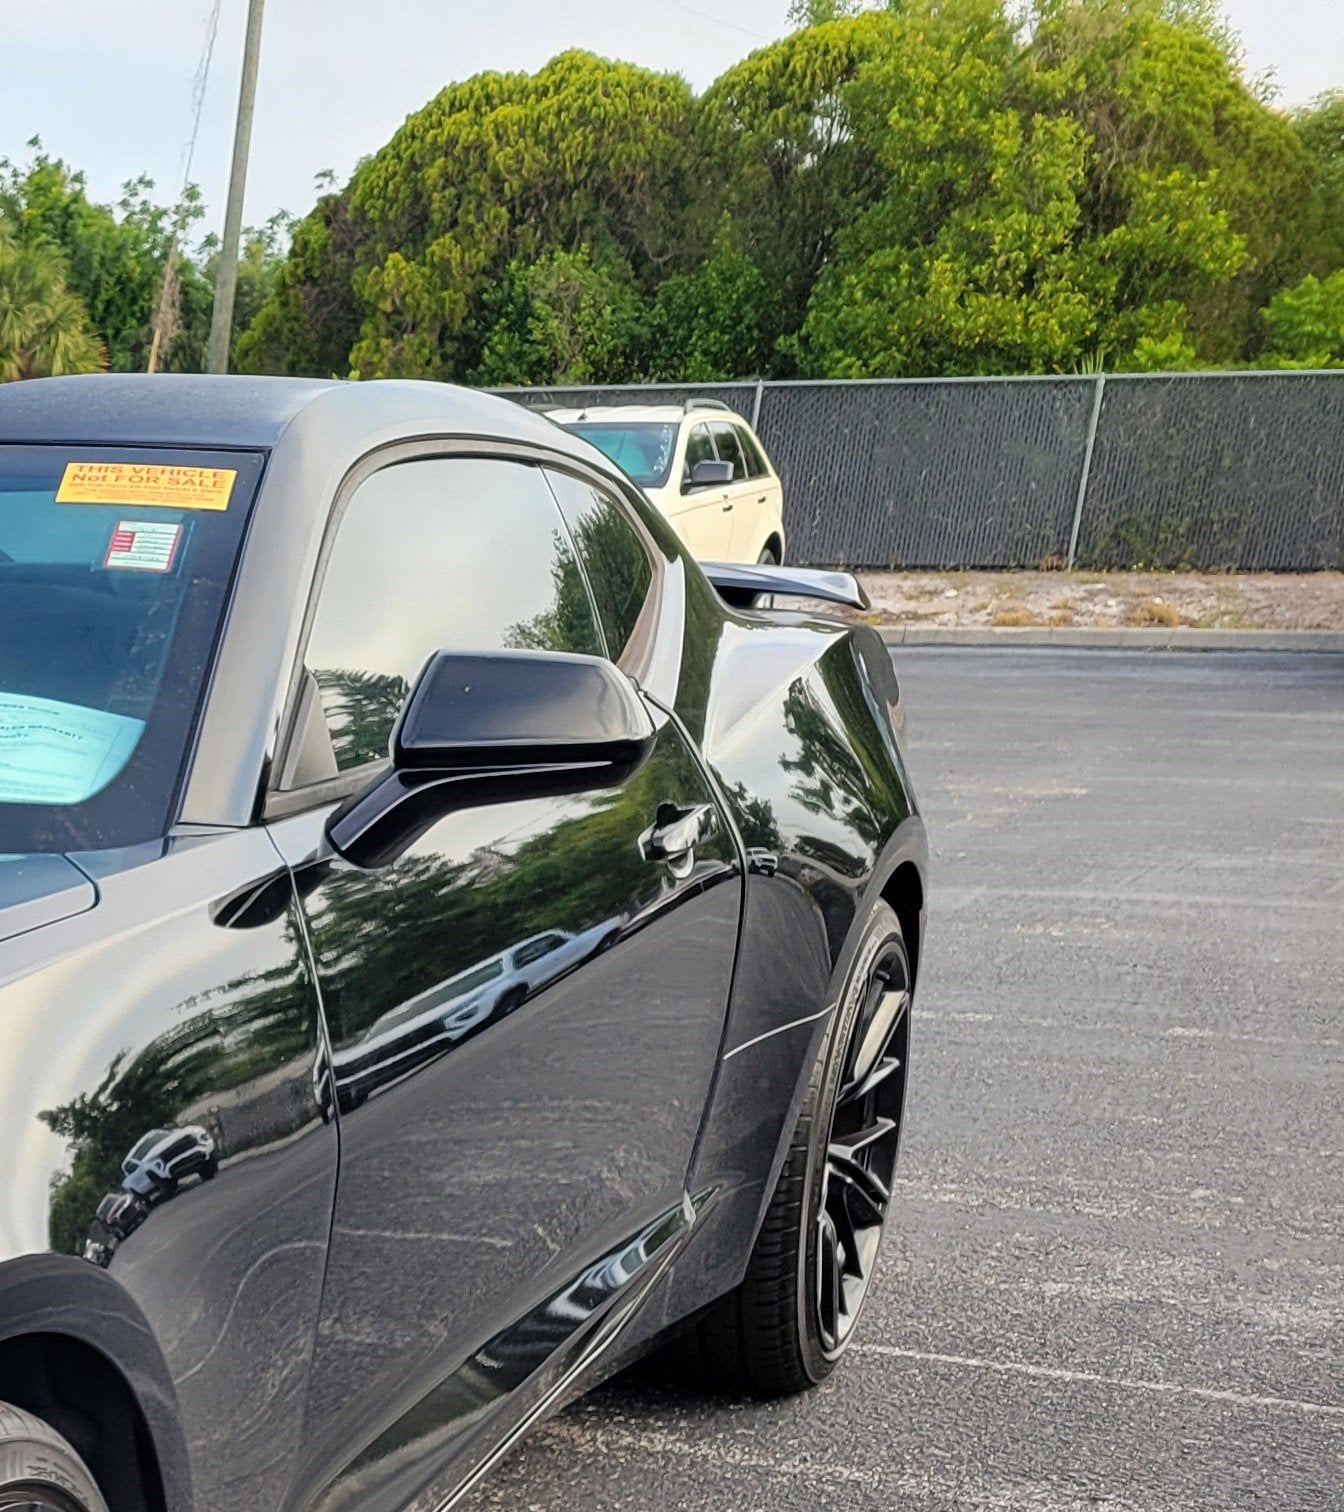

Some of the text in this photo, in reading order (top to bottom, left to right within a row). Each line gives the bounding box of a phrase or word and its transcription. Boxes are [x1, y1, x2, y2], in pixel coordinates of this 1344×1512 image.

[76, 465, 226, 479] THIS VEHICLE
[71, 473, 108, 482] Not
[114, 475, 160, 485] FOR
[167, 477, 226, 489] SALE
